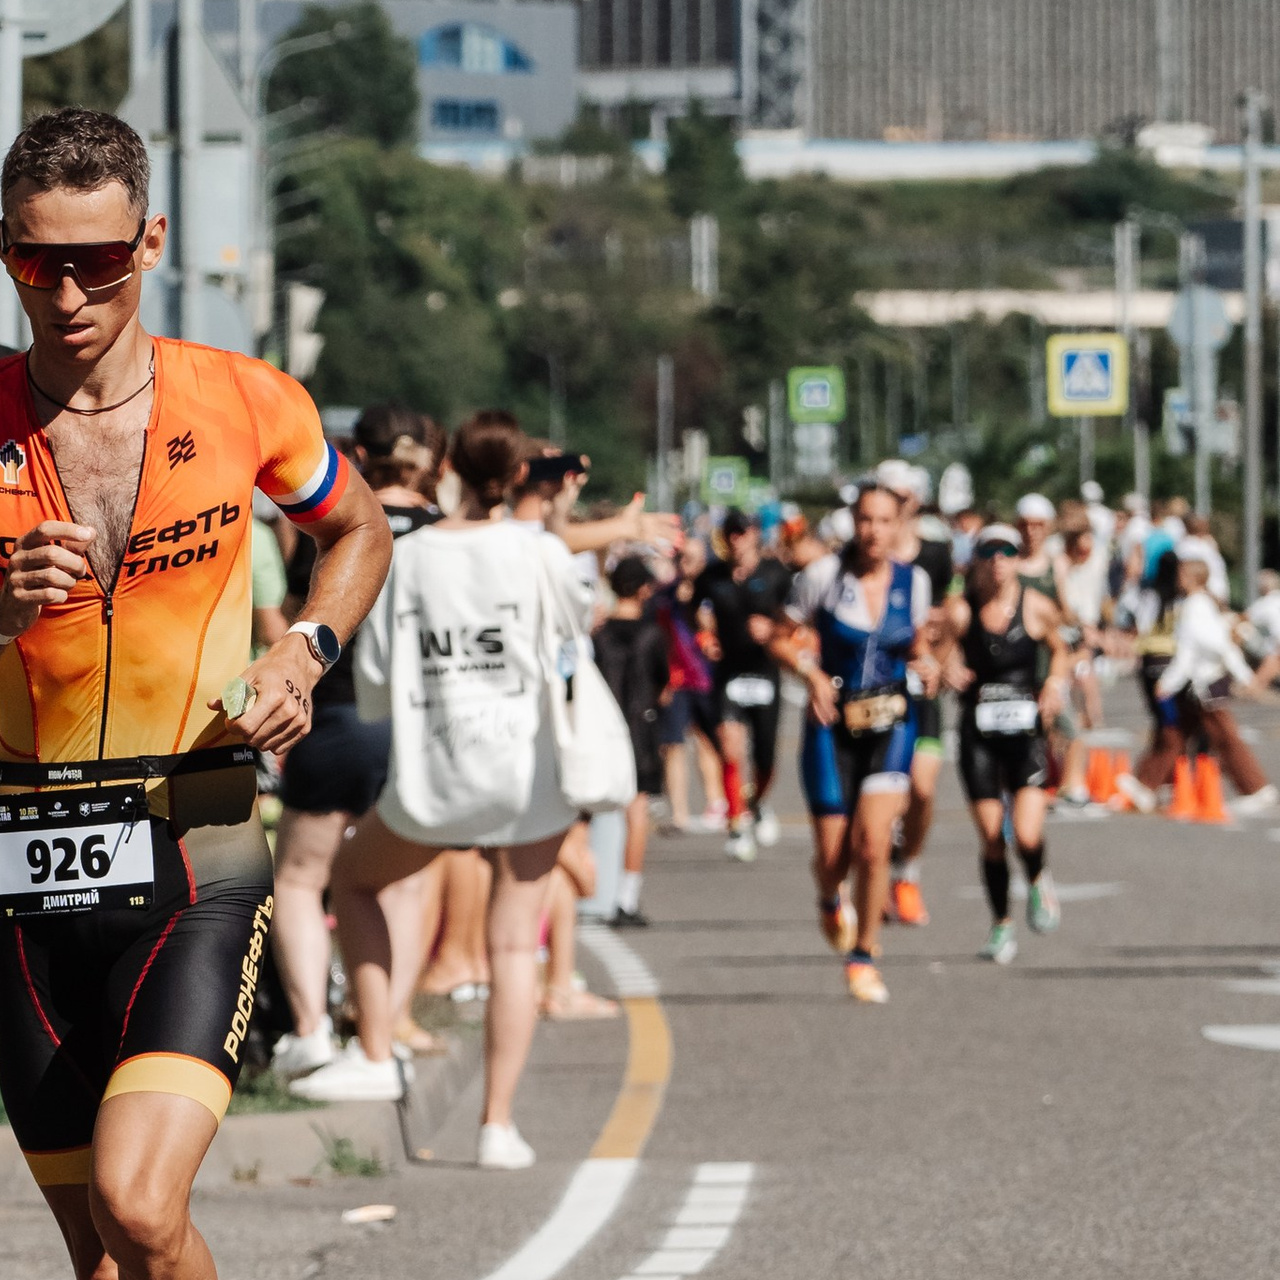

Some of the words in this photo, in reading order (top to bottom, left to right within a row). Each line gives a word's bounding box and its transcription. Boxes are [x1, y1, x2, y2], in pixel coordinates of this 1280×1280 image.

[285, 679, 310, 716] 926
[26, 834, 111, 884] 926
[42, 888, 100, 910] ДМИТРИЙ
[129, 896, 144, 906] 113
[223, 895, 274, 1064] РОСНЕФТЬ
